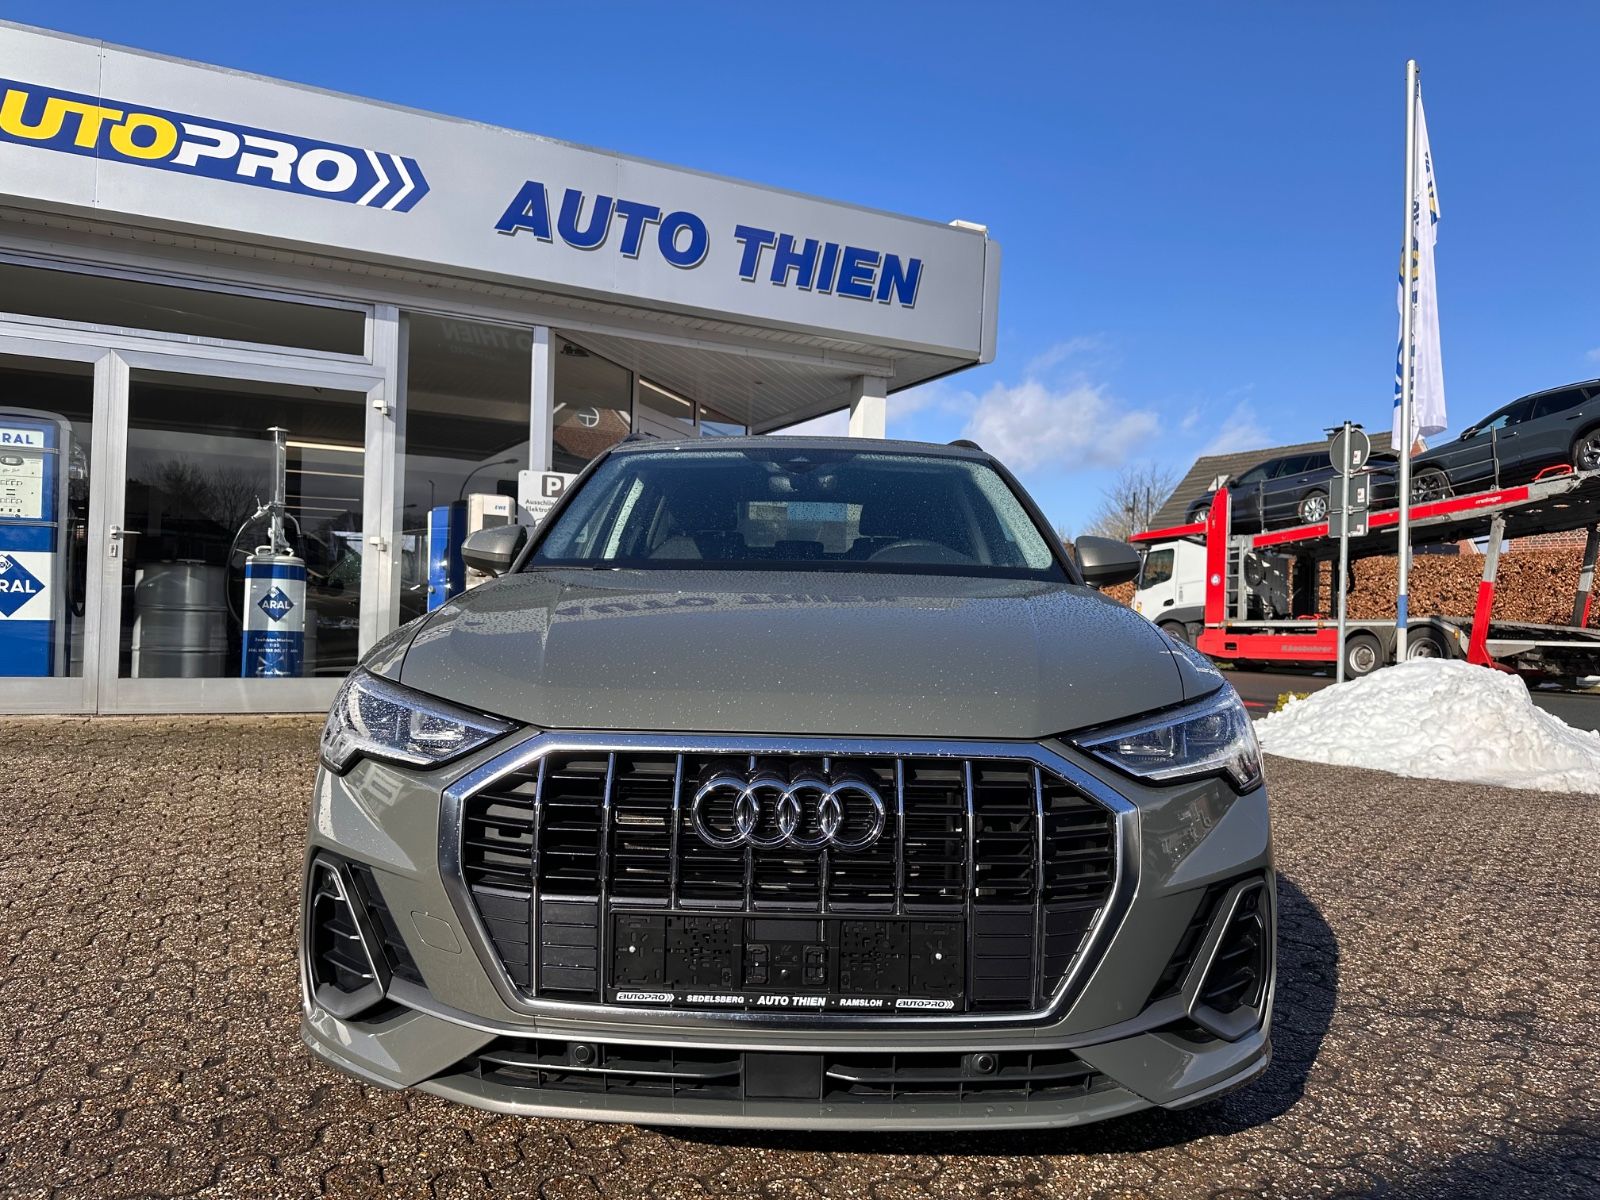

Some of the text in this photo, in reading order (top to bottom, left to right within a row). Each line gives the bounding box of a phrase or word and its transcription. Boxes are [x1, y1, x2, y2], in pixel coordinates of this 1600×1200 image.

[0, 88, 358, 193] UTOPRO
[494, 180, 924, 308] AUTO THIEN
[2, 432, 34, 445] RAL
[0, 579, 37, 594] RAL
[261, 600, 291, 610] ARAL
[686, 994, 745, 1004] SEDELSBERG
[756, 995, 789, 1006] AUTO
[792, 996, 827, 1007] THIEN
[839, 998, 883, 1007] RAMSLOH
